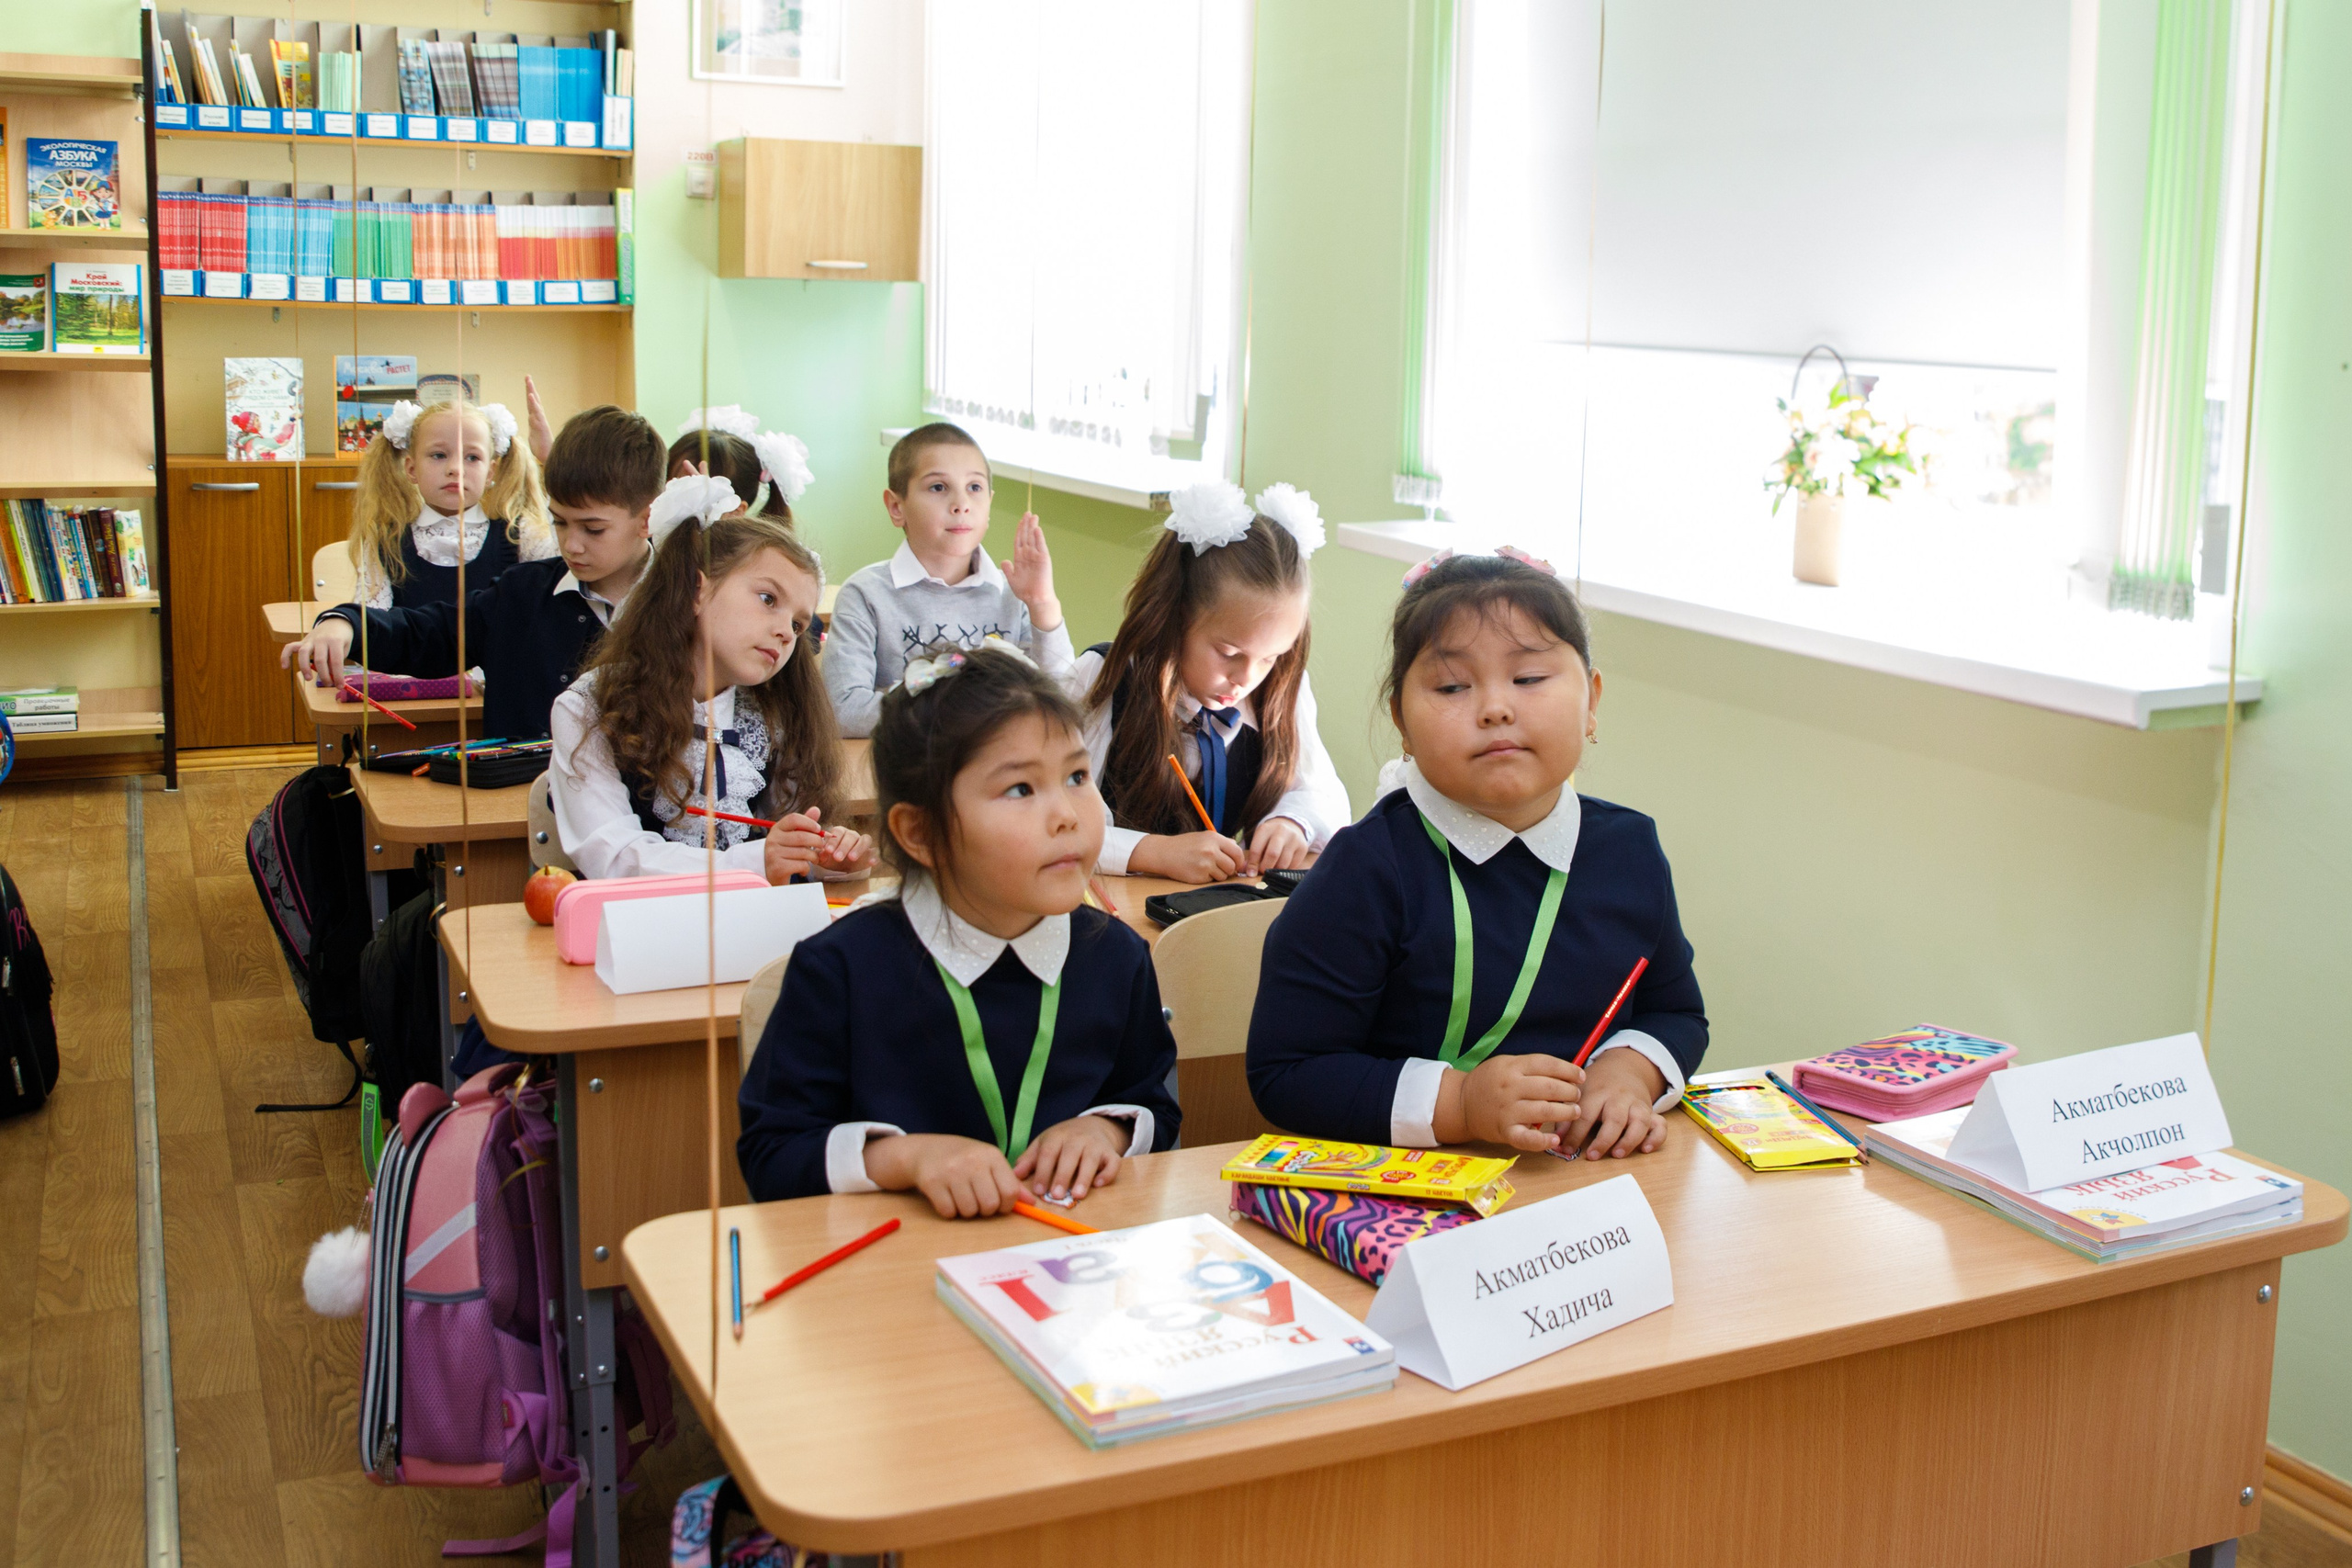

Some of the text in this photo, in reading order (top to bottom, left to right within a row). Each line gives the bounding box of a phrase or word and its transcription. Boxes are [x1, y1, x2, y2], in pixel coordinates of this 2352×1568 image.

[40, 142, 107, 154] ЭКОЛОГИЧЕСКАЯ
[49, 151, 98, 162] АЗБУКА
[85, 273, 107, 281] Край
[2052, 1076, 2188, 1123] Акматбекова
[2082, 1123, 2186, 1164] Акчолпон
[2062, 1170, 2154, 1197] язык
[2112, 1168, 2239, 1202] Русский
[1475, 1225, 1632, 1300] Акматбекова
[1521, 1288, 1614, 1338] Хадича
